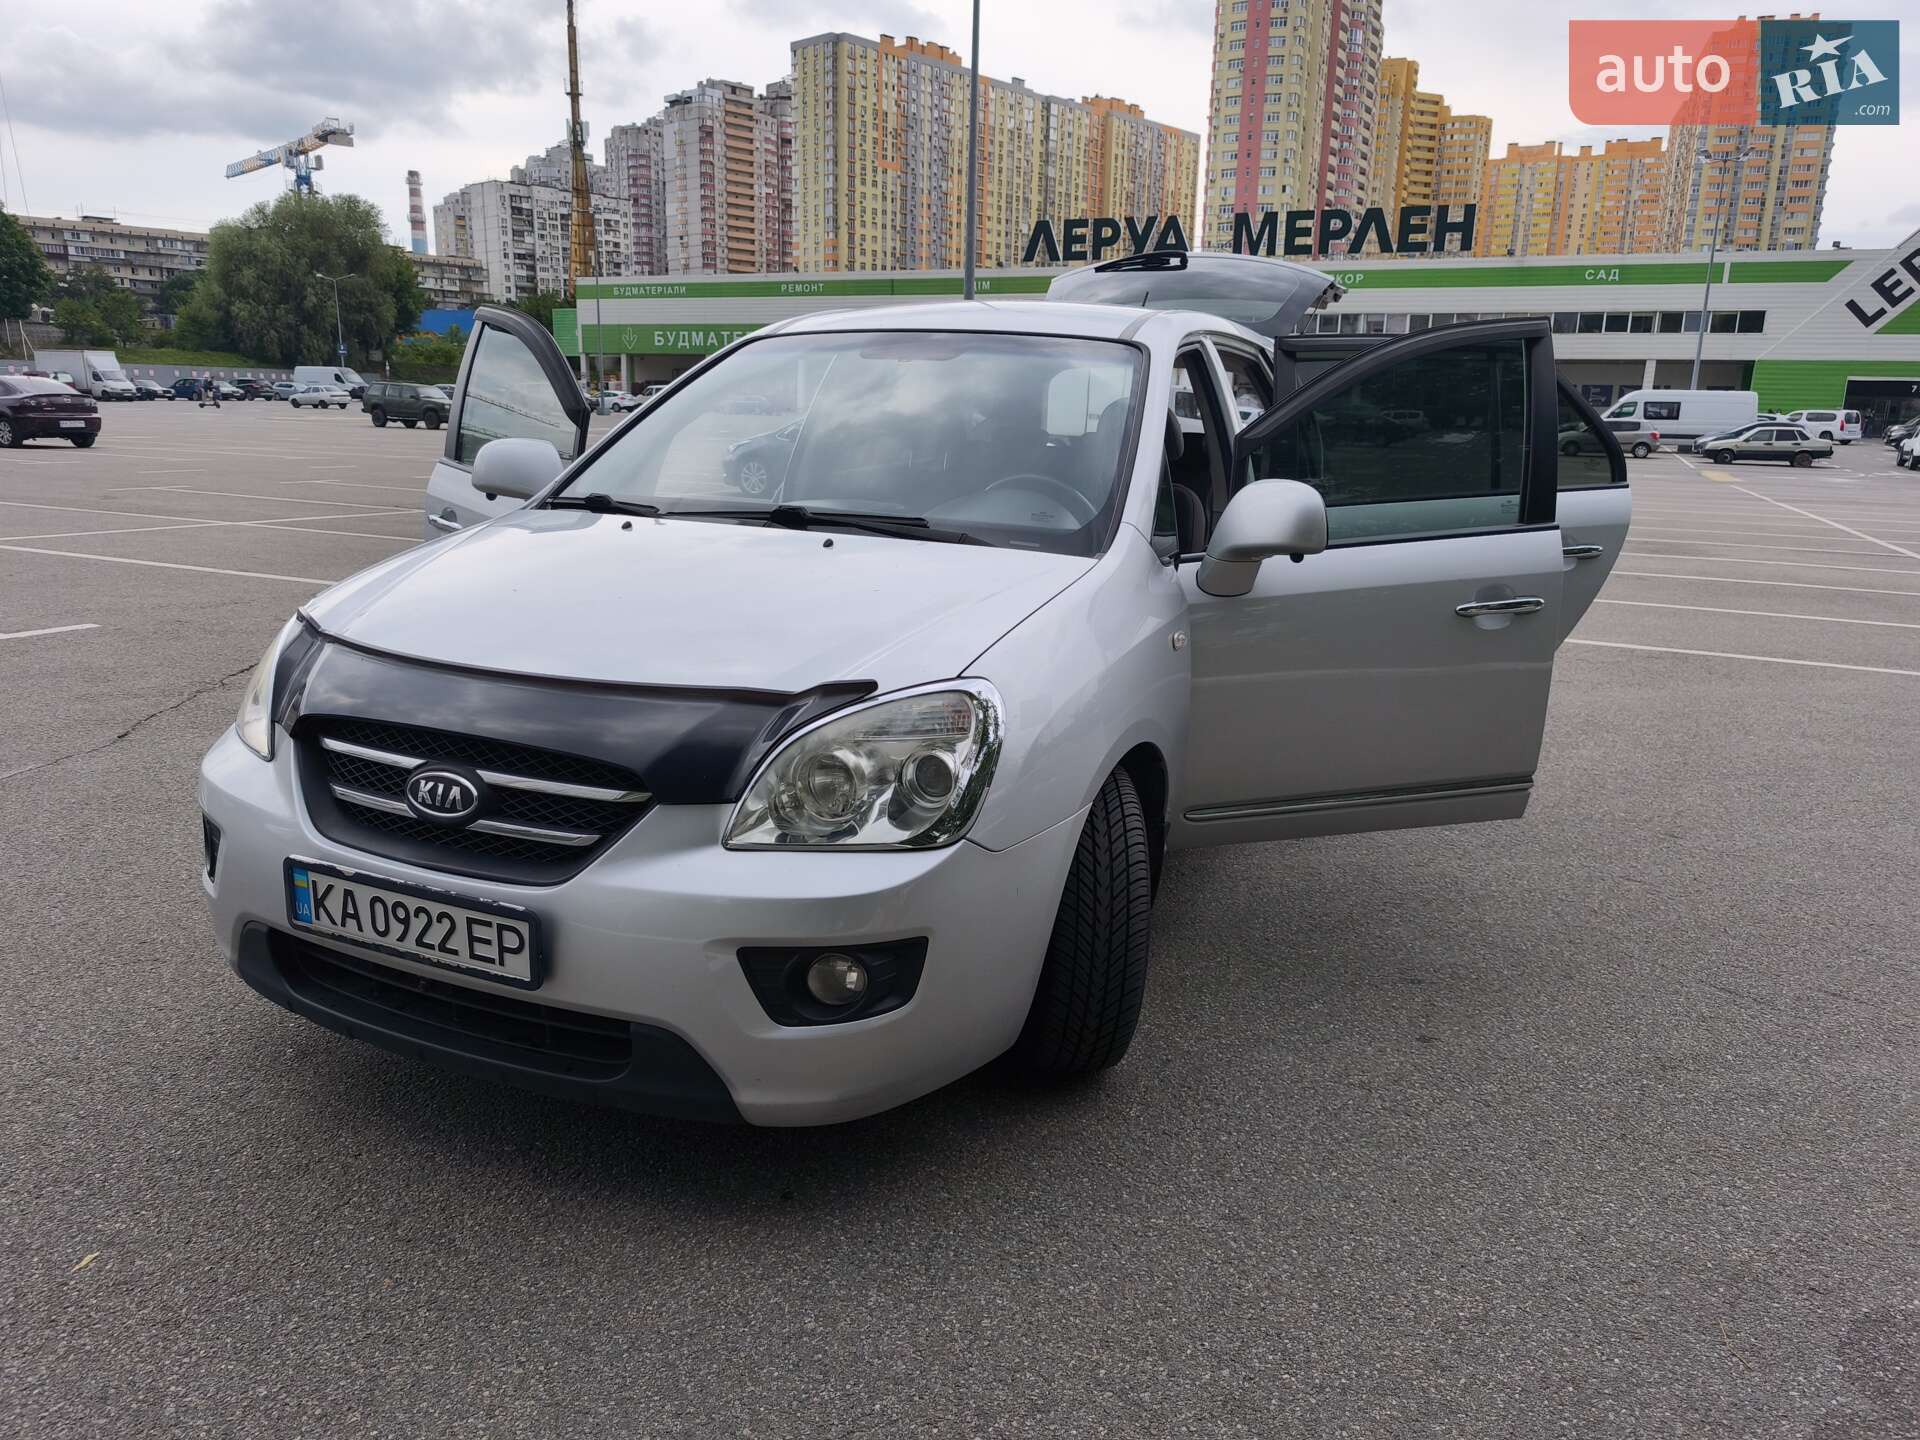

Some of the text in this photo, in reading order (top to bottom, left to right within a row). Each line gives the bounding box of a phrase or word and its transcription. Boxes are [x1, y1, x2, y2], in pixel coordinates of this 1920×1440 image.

[1023, 203, 1477, 262] ЛЕРУА МЕРЛЕН
[1333, 273, 1364, 285] КОР
[1584, 268, 1621, 282] САД
[613, 285, 687, 297] БУДМАТЕРІАЛИ
[781, 283, 825, 293] РЕМОНТ
[654, 331, 750, 349] БУДМАТЕ
[417, 779, 463, 811] KIA
